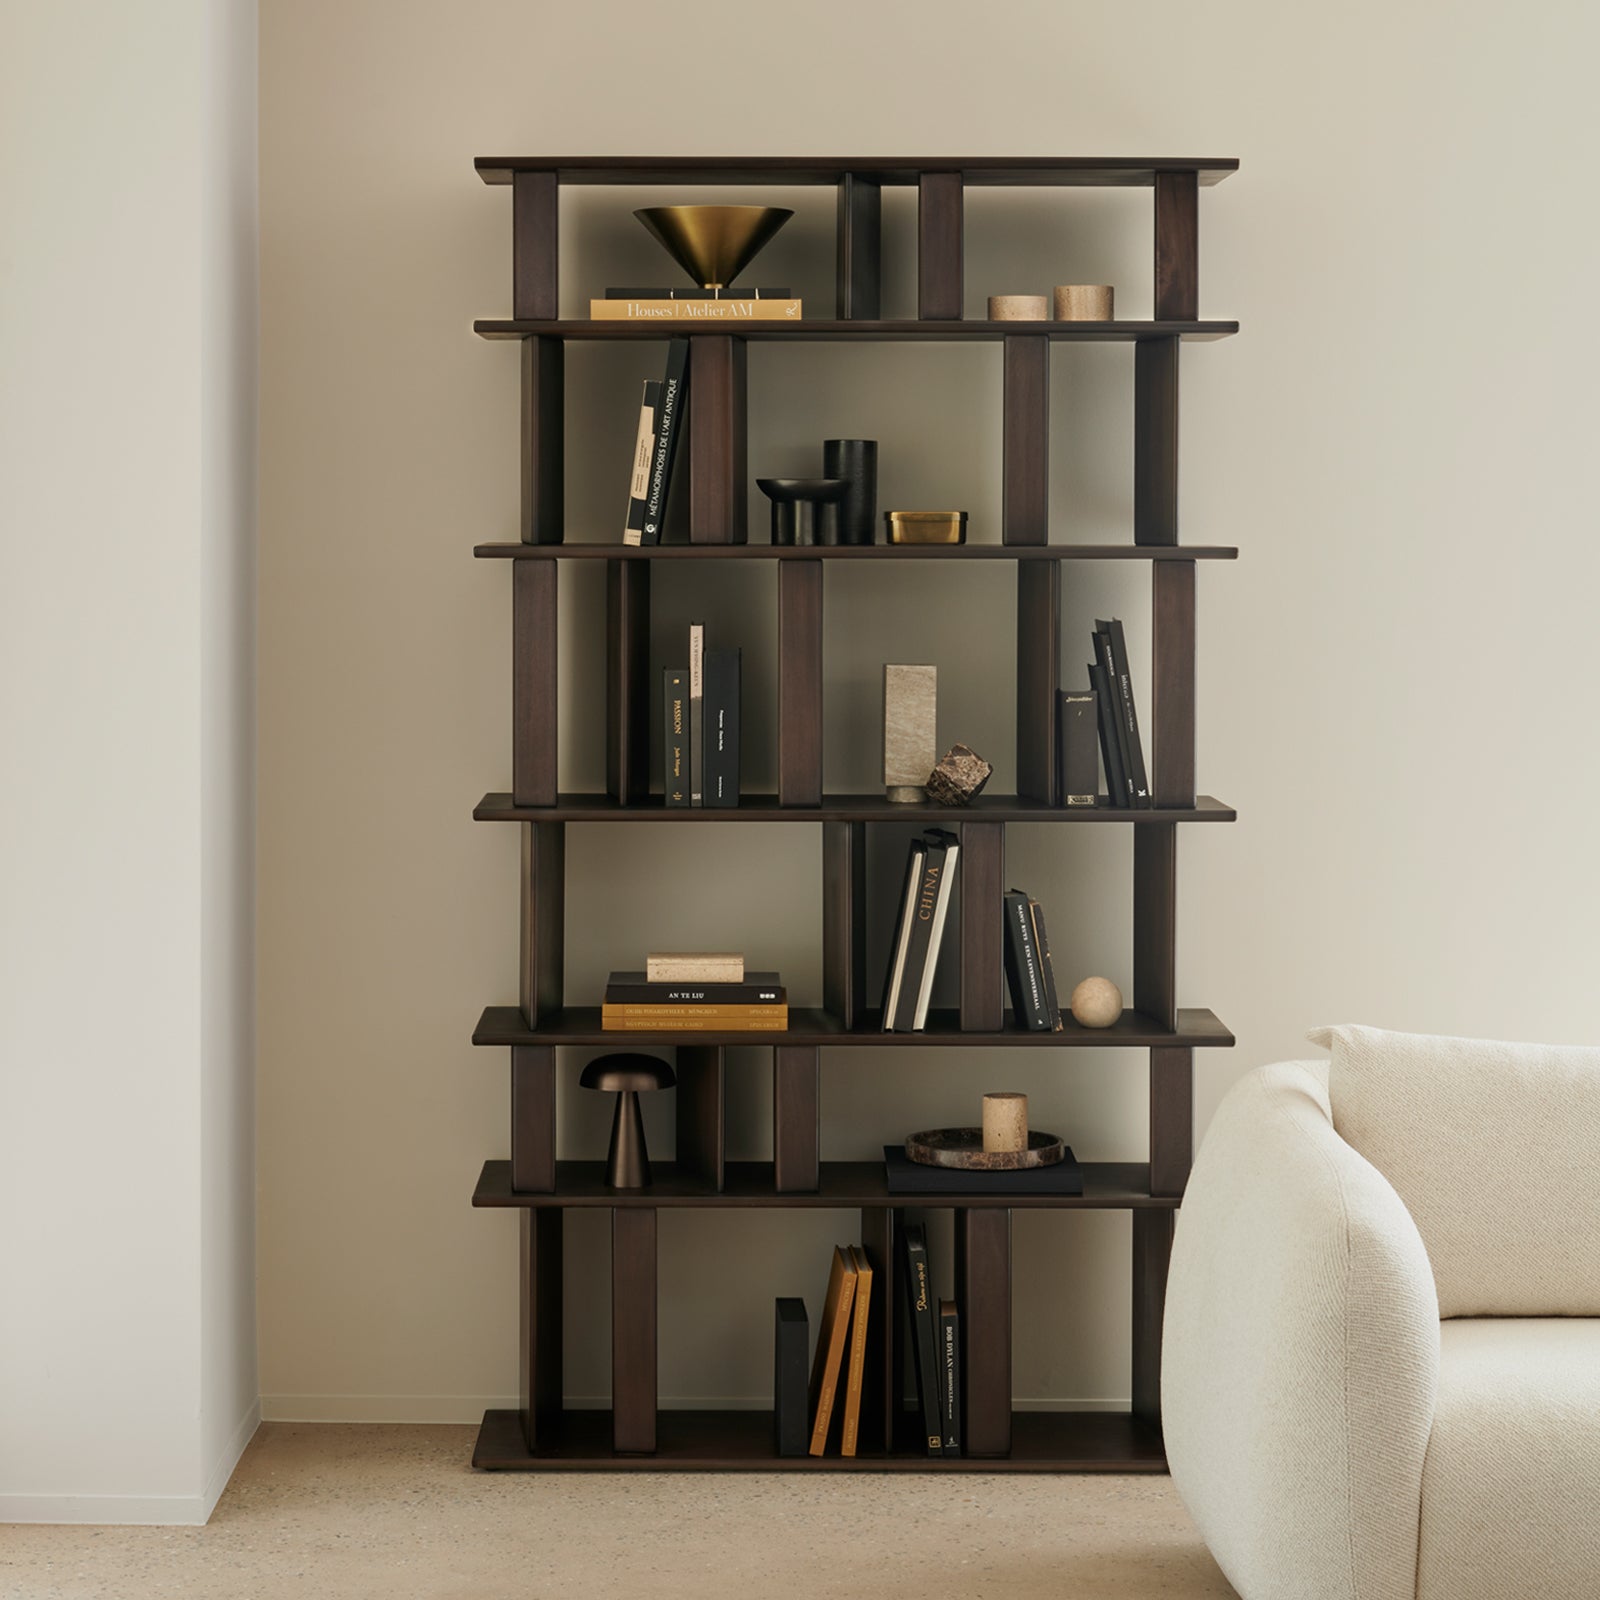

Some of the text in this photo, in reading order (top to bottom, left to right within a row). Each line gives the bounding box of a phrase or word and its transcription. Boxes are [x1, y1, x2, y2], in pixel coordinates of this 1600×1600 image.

[627, 303, 673, 317] Houses
[682, 303, 726, 317] Atelier
[727, 303, 753, 317] AM
[648, 379, 678, 516] MÉTAMORPHOSES DE L'ART ANTIQUE
[674, 700, 682, 734] PASSION
[918, 867, 939, 921] CHINA
[1017, 904, 1025, 923] MANU
[945, 1326, 953, 1341] BOB
[946, 1342, 954, 1368] DYLAN
